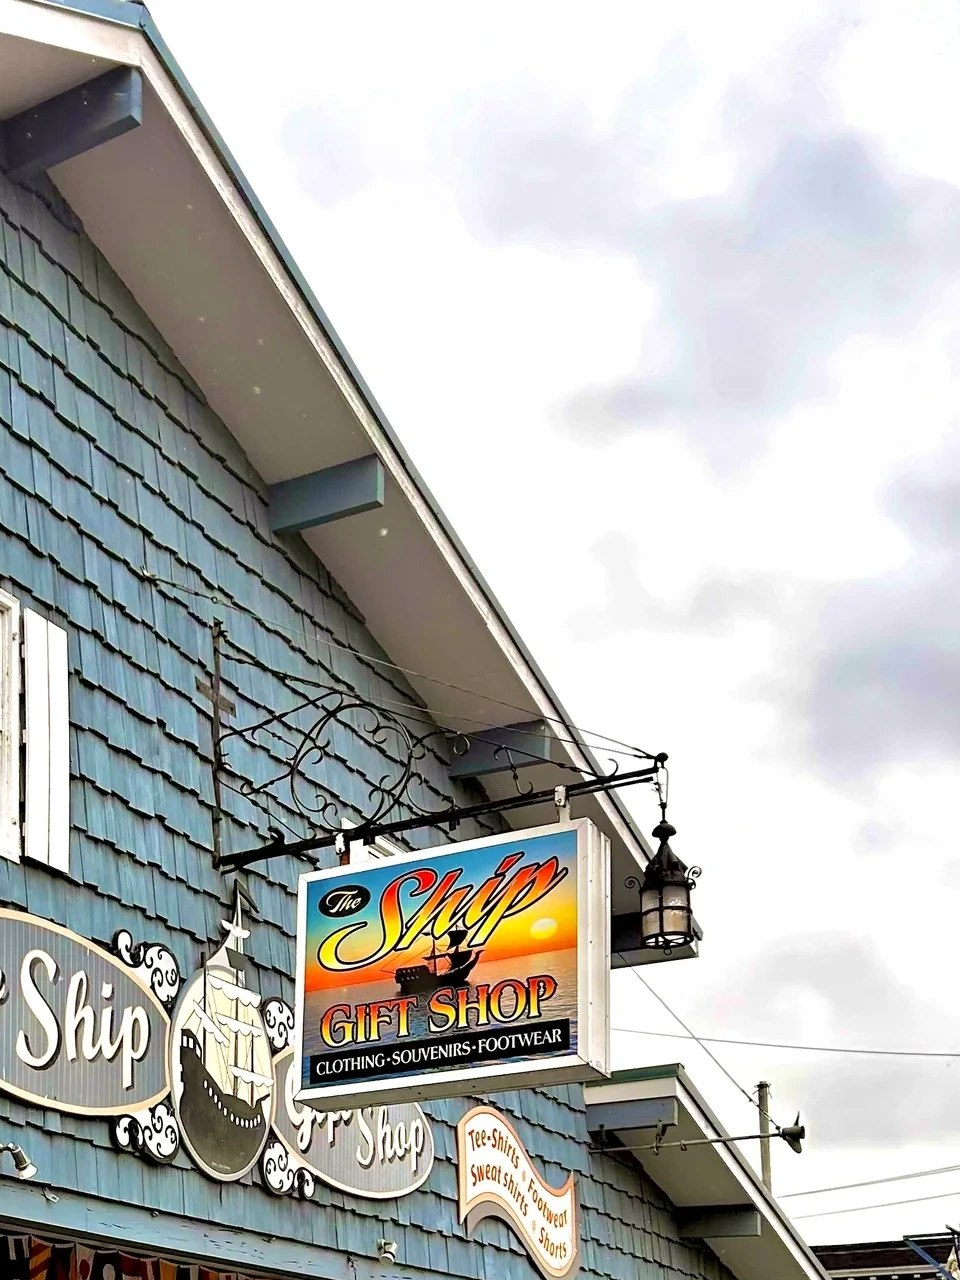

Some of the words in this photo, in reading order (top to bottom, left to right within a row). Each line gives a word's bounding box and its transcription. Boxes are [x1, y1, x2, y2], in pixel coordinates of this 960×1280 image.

[317, 850, 569, 972] Ship
[326, 889, 362, 915] The
[16, 949, 152, 1090] Ship
[320, 995, 418, 1048] GIFT
[427, 975, 559, 1034] SHOP
[356, 1105, 424, 1172] Shop
[527, 1177, 568, 1229] Footwear
[538, 1227, 568, 1260] Shorts
